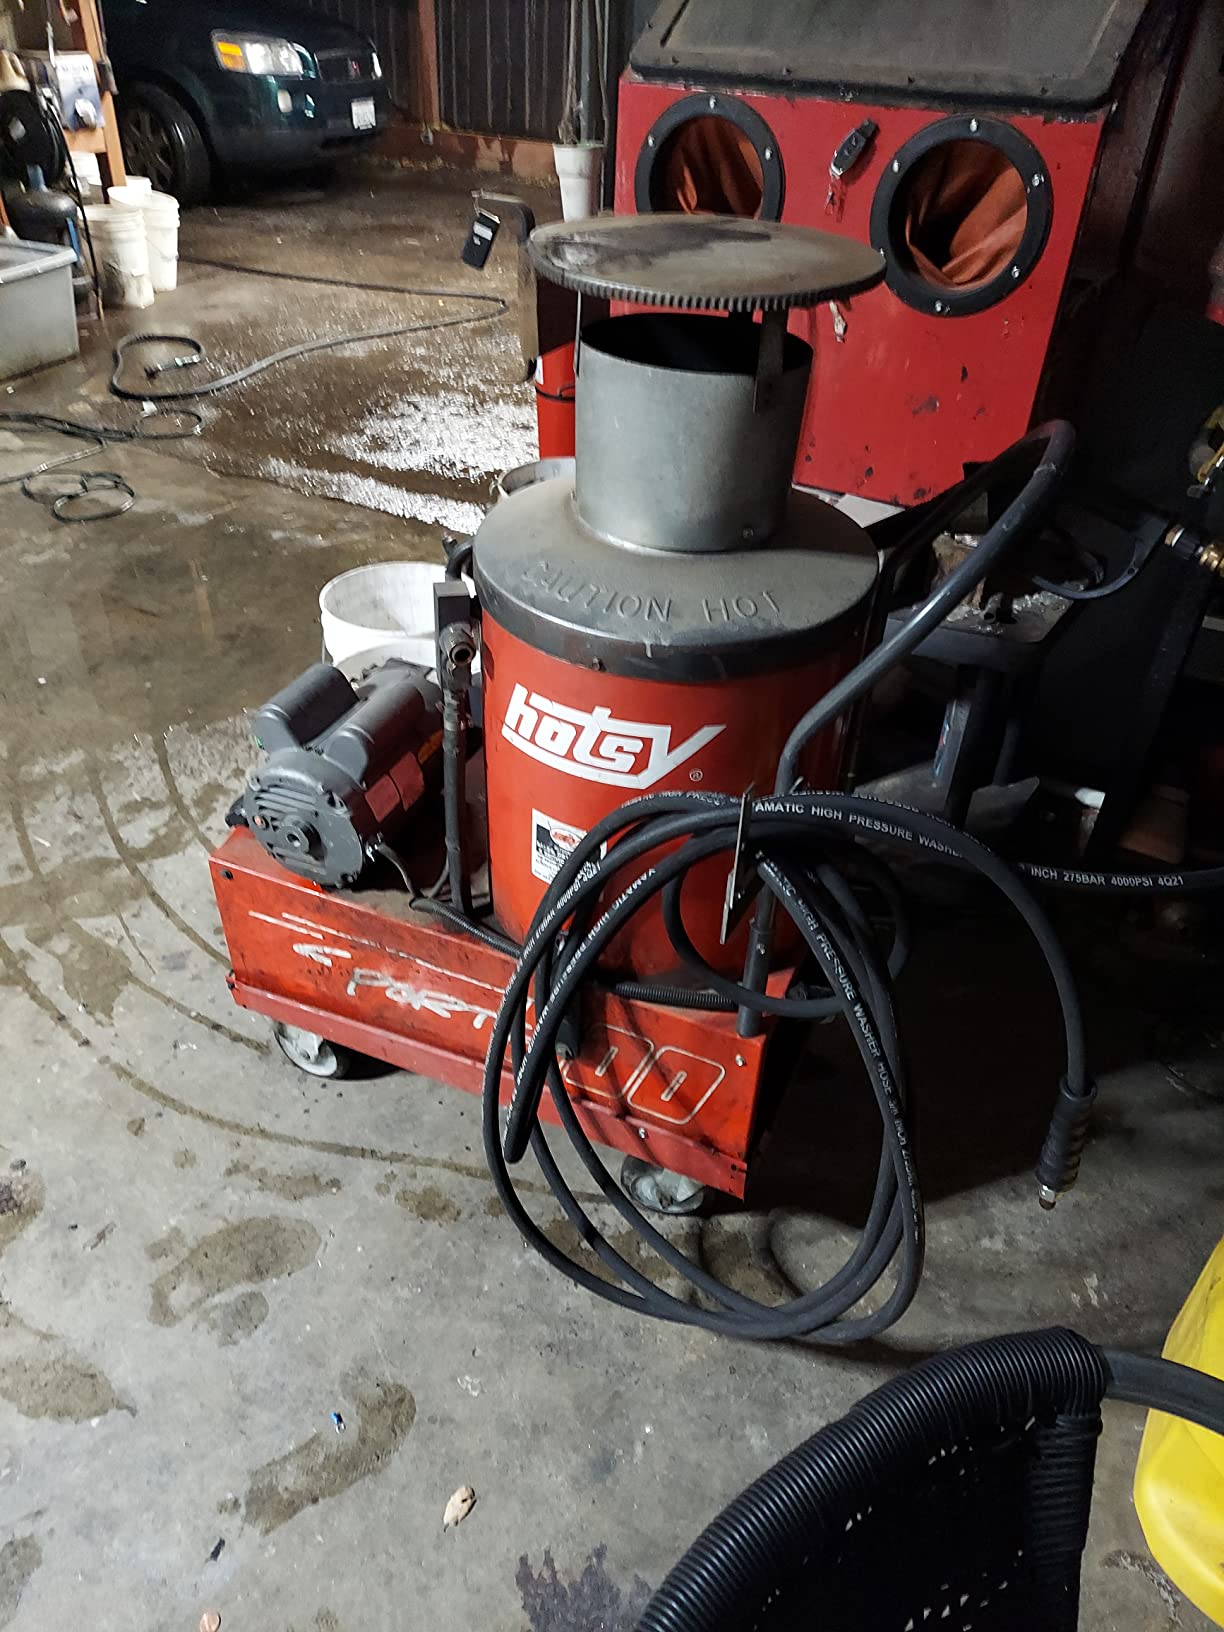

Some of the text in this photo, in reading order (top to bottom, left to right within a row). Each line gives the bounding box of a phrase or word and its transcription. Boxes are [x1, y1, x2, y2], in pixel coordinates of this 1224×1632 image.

[521, 561, 780, 623] CAUTION HOT
[501, 682, 727, 790] hotsy
[811, 805, 843, 821] HIGH
[849, 814, 913, 841] PRESSURE
[1031, 866, 1184, 887] INCH 275BAR 4000PSI 4Q21
[816, 933, 857, 1001] PRESSURE
[853, 1002, 881, 1058] WASHER
